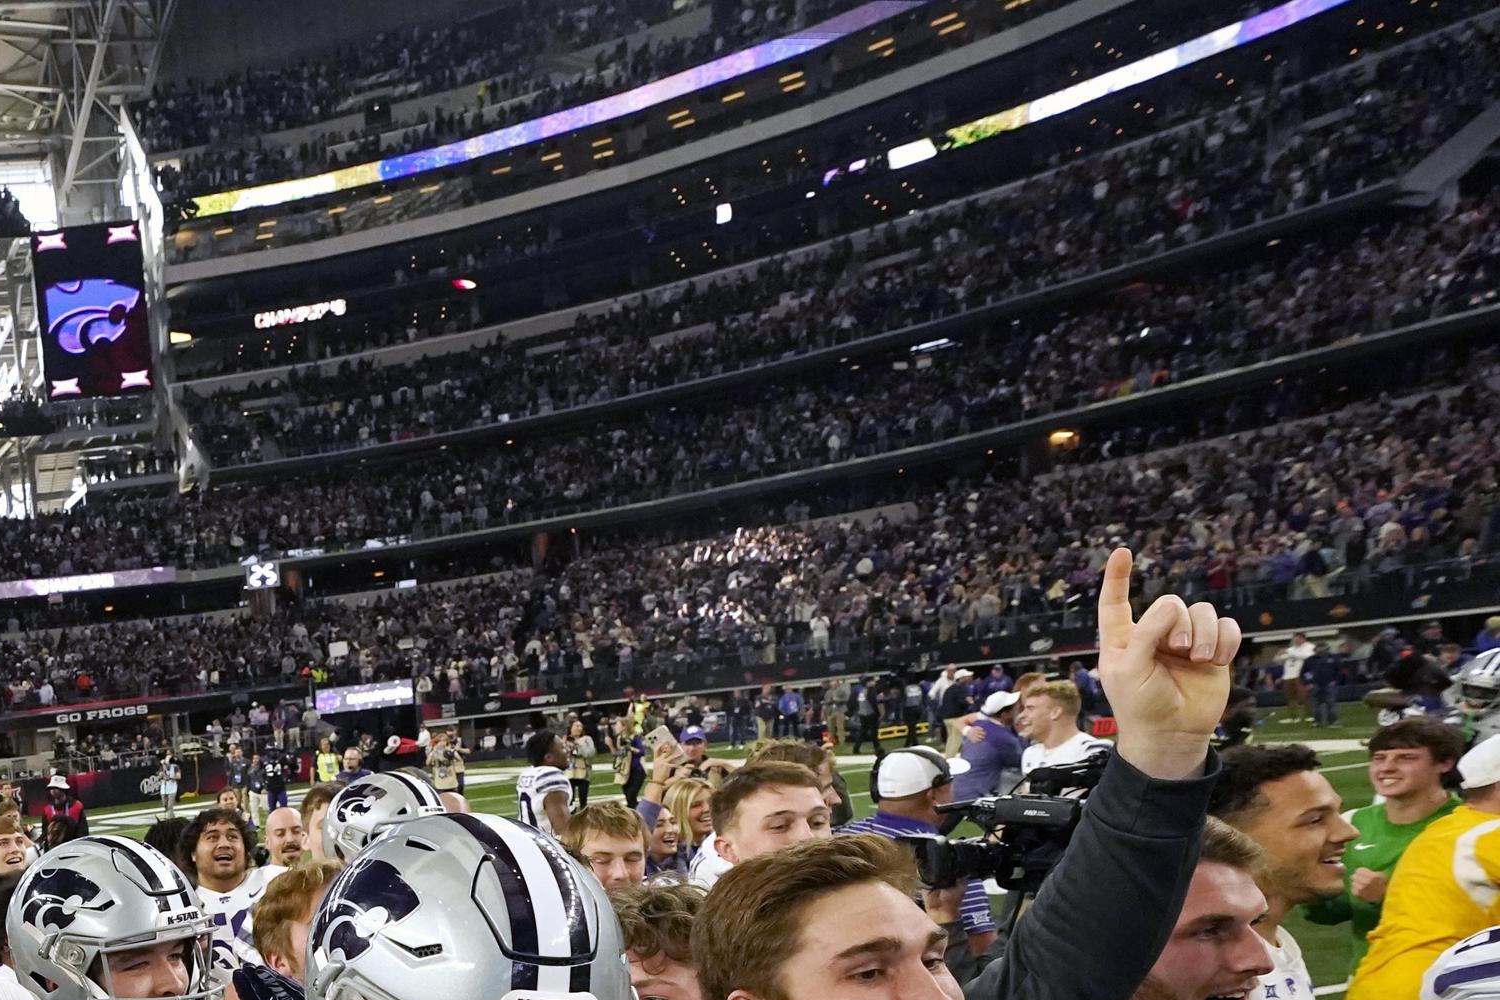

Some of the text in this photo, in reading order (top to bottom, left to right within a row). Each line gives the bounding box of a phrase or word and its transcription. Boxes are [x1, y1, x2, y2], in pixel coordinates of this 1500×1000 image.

[56, 704, 149, 724] GO FROGS
[266, 763, 282, 777] 24
[167, 909, 200, 925] K-STATE
